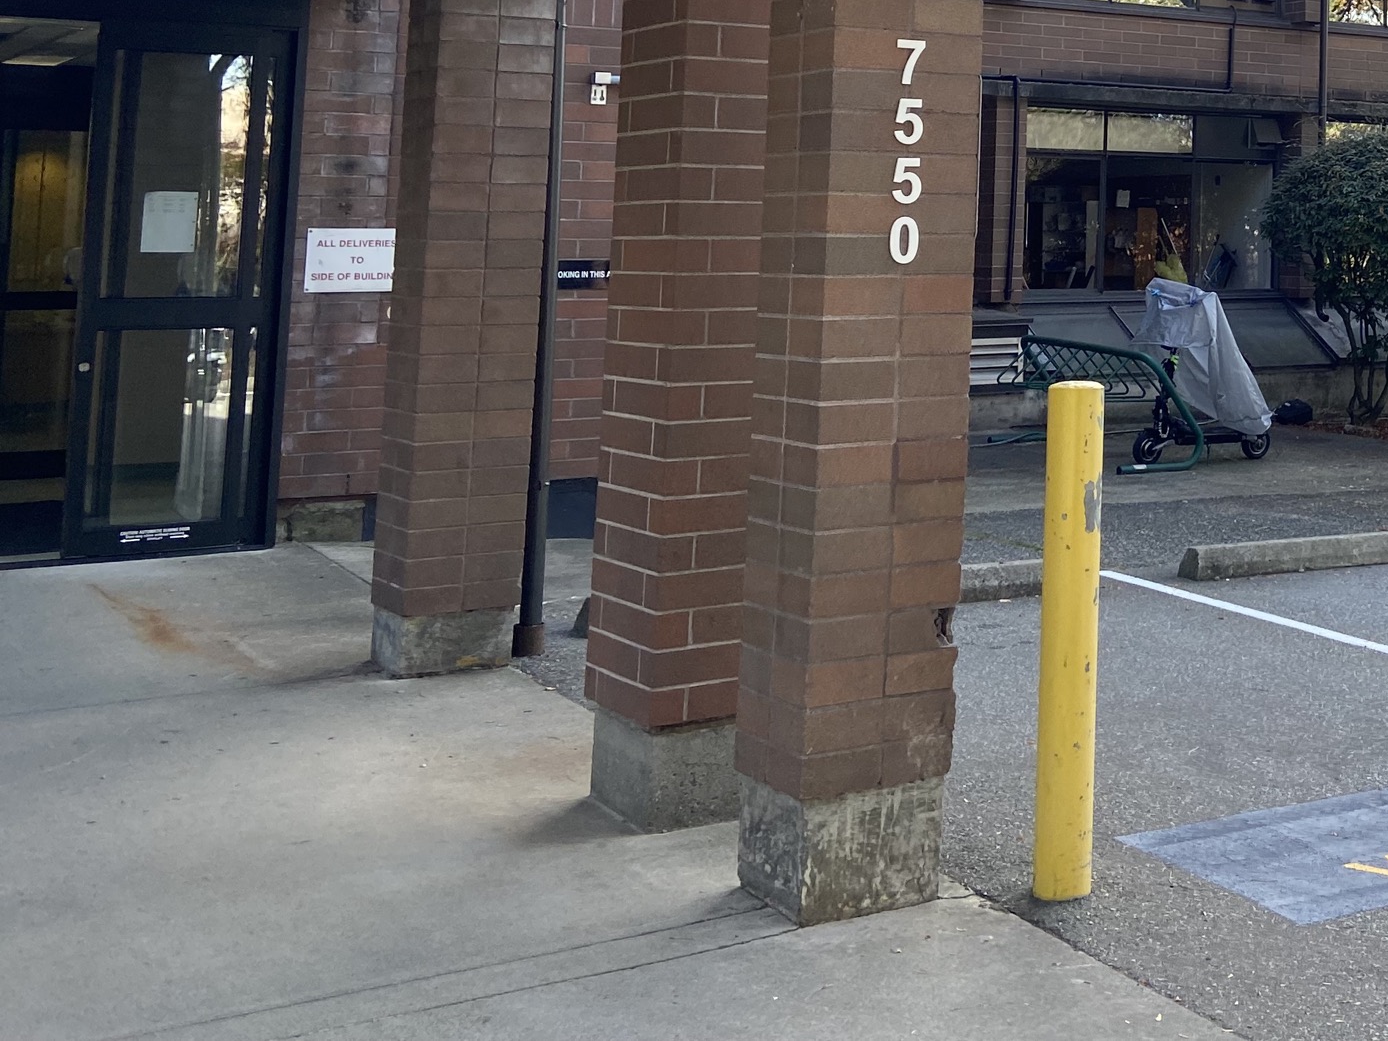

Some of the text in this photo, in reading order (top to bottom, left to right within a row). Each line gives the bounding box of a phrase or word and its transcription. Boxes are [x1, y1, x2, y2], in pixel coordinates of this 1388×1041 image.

[888, 38, 927, 265] 7550
[316, 239, 336, 248] ALL
[350, 256, 364, 264] TO
[310, 272, 335, 281] SIDE
[337, 272, 352, 281] OF
[581, 270, 589, 278] IN
[589, 270, 606, 278] THIS
